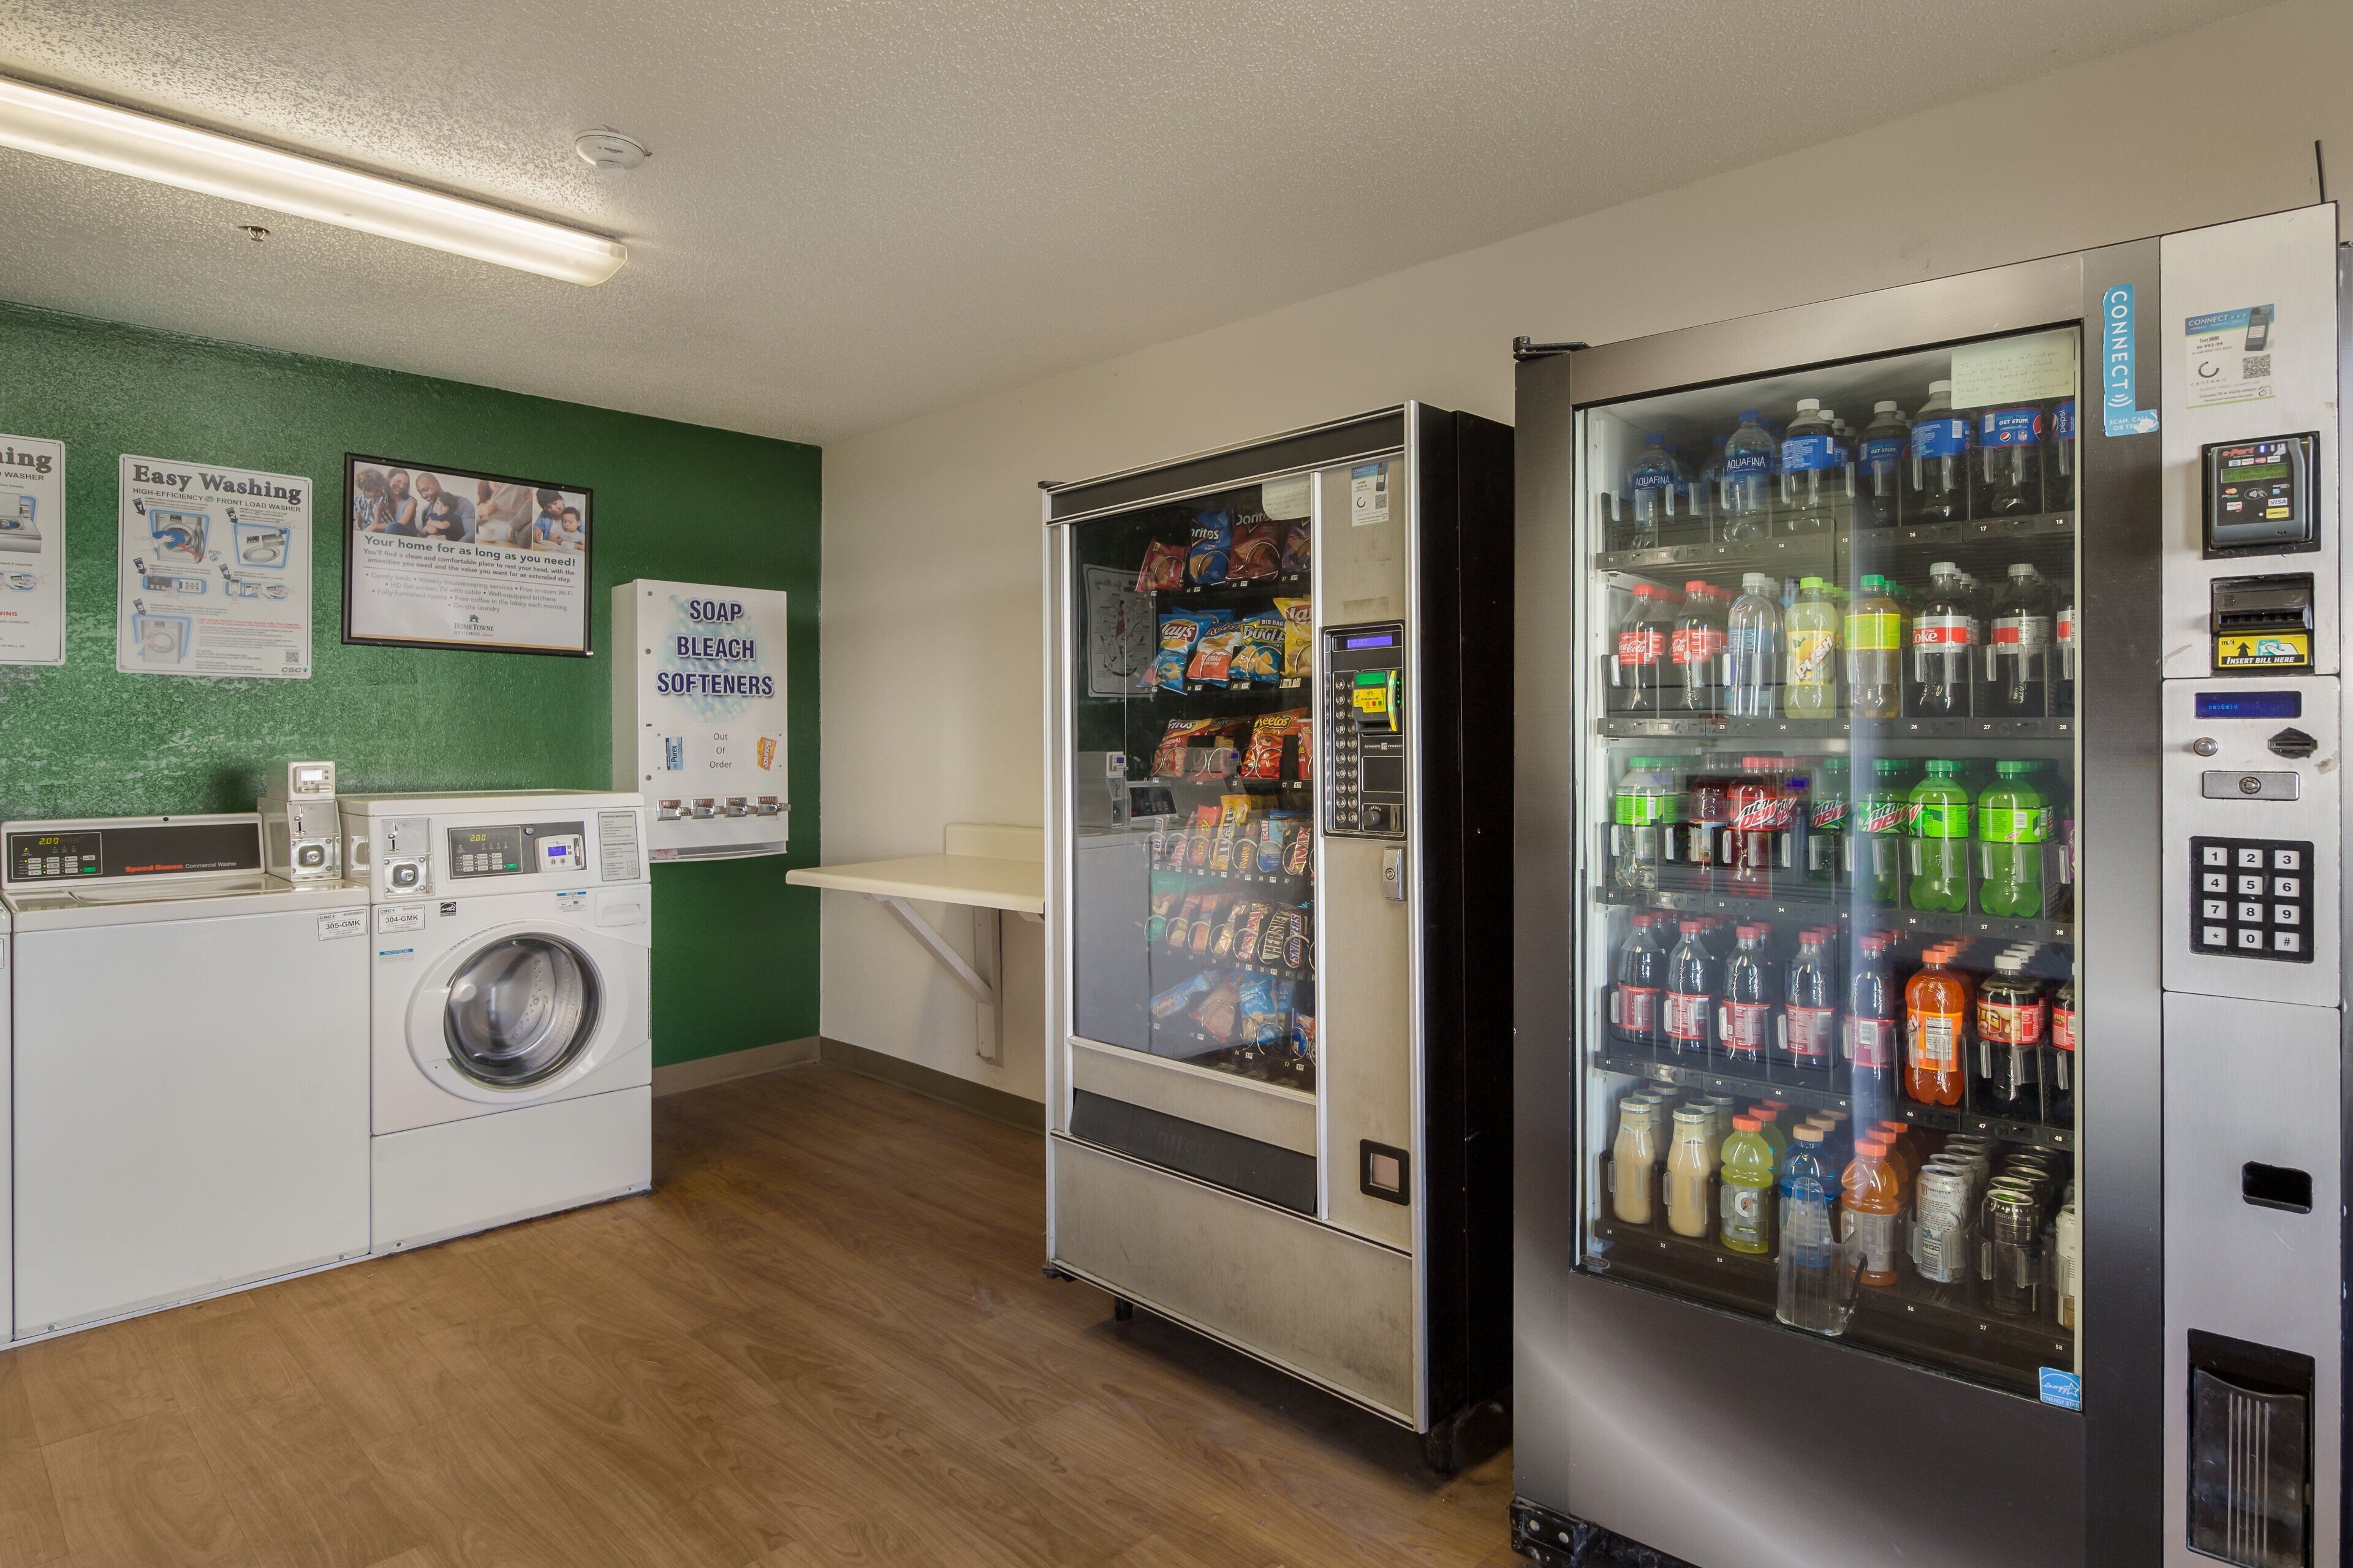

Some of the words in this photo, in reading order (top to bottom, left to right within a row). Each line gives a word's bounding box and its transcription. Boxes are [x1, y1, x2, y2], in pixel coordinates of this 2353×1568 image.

[2189, 314, 2229, 327] CONNECT
[2111, 290, 2128, 389] CONNECT
[2191, 377, 2227, 386] canteen
[1727, 456, 1766, 471] AQUAFINA
[4, 472, 44, 480] WASHER
[1635, 475, 1670, 487] AQUAFINA
[133, 464, 192, 492] Easy
[199, 472, 301, 505] Washing
[133, 488, 203, 501] HIGH-EFFICIENCY
[365, 536, 394, 547] Your
[398, 539, 433, 551] home
[437, 543, 455, 553] for
[476, 547, 500, 560] long
[544, 558, 575, 566] need!
[438, 557, 476, 566] comfortable
[371, 572, 393, 581] Comfy
[419, 577, 442, 585] Weekly
[444, 579, 488, 589] housekeeping
[488, 591, 531, 600] Well-equipped
[689, 600, 743, 622] SOAP
[1244, 626, 1285, 642] BUGLE
[1912, 629, 1938, 643] Coke
[677, 636, 754, 659] BLEACH
[657, 673, 773, 696] SOFTENERS
[763, 740, 772, 767] Bounce
[1239, 842, 1251, 868] AWAK
[2283, 855, 2291, 864] 3
[2211, 879, 2219, 887] 4
[2246, 881, 2254, 889] 5
[2283, 883, 2291, 892] 6
[2211, 905, 2219, 914] 7
[2246, 907, 2254, 916] 8
[2283, 910, 2291, 918] 9
[325, 920, 360, 930] 305-GMK
[385, 915, 419, 923] 304-GMK
[2246, 934, 2254, 943] 0
[2043, 1395, 2065, 1406] ENERGY
[2066, 1400, 2080, 1409] STAR
